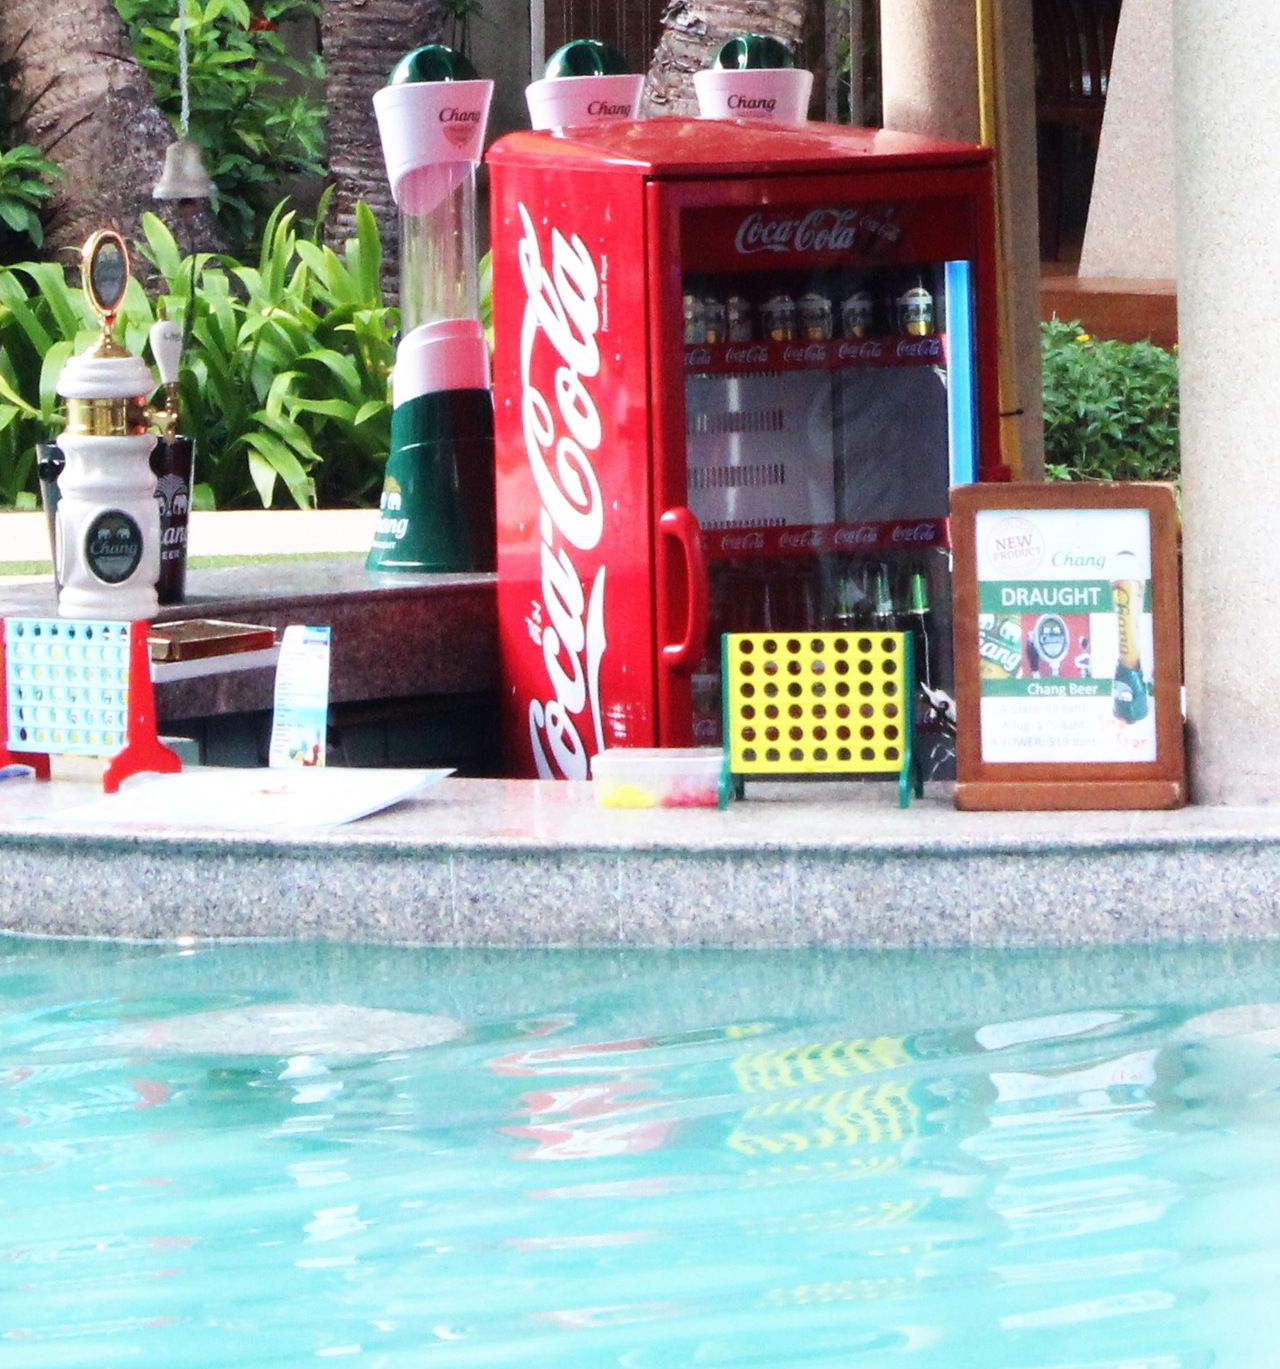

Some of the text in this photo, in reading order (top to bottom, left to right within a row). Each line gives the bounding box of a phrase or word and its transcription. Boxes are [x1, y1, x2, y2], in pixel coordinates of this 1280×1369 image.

[586, 99, 632, 118] Chang
[727, 93, 777, 112] Chang
[438, 106, 482, 124] Chang
[734, 208, 859, 254] Coca-Cola
[89, 540, 139, 558] Chang
[995, 534, 1033, 552] NEW
[992, 546, 1042, 561] PRODUCT
[1050, 551, 1107, 570] Chang
[1000, 586, 1102, 607] DRAUGHT
[979, 635, 1022, 672] ang
[1026, 682, 1099, 697] Chang Beer
